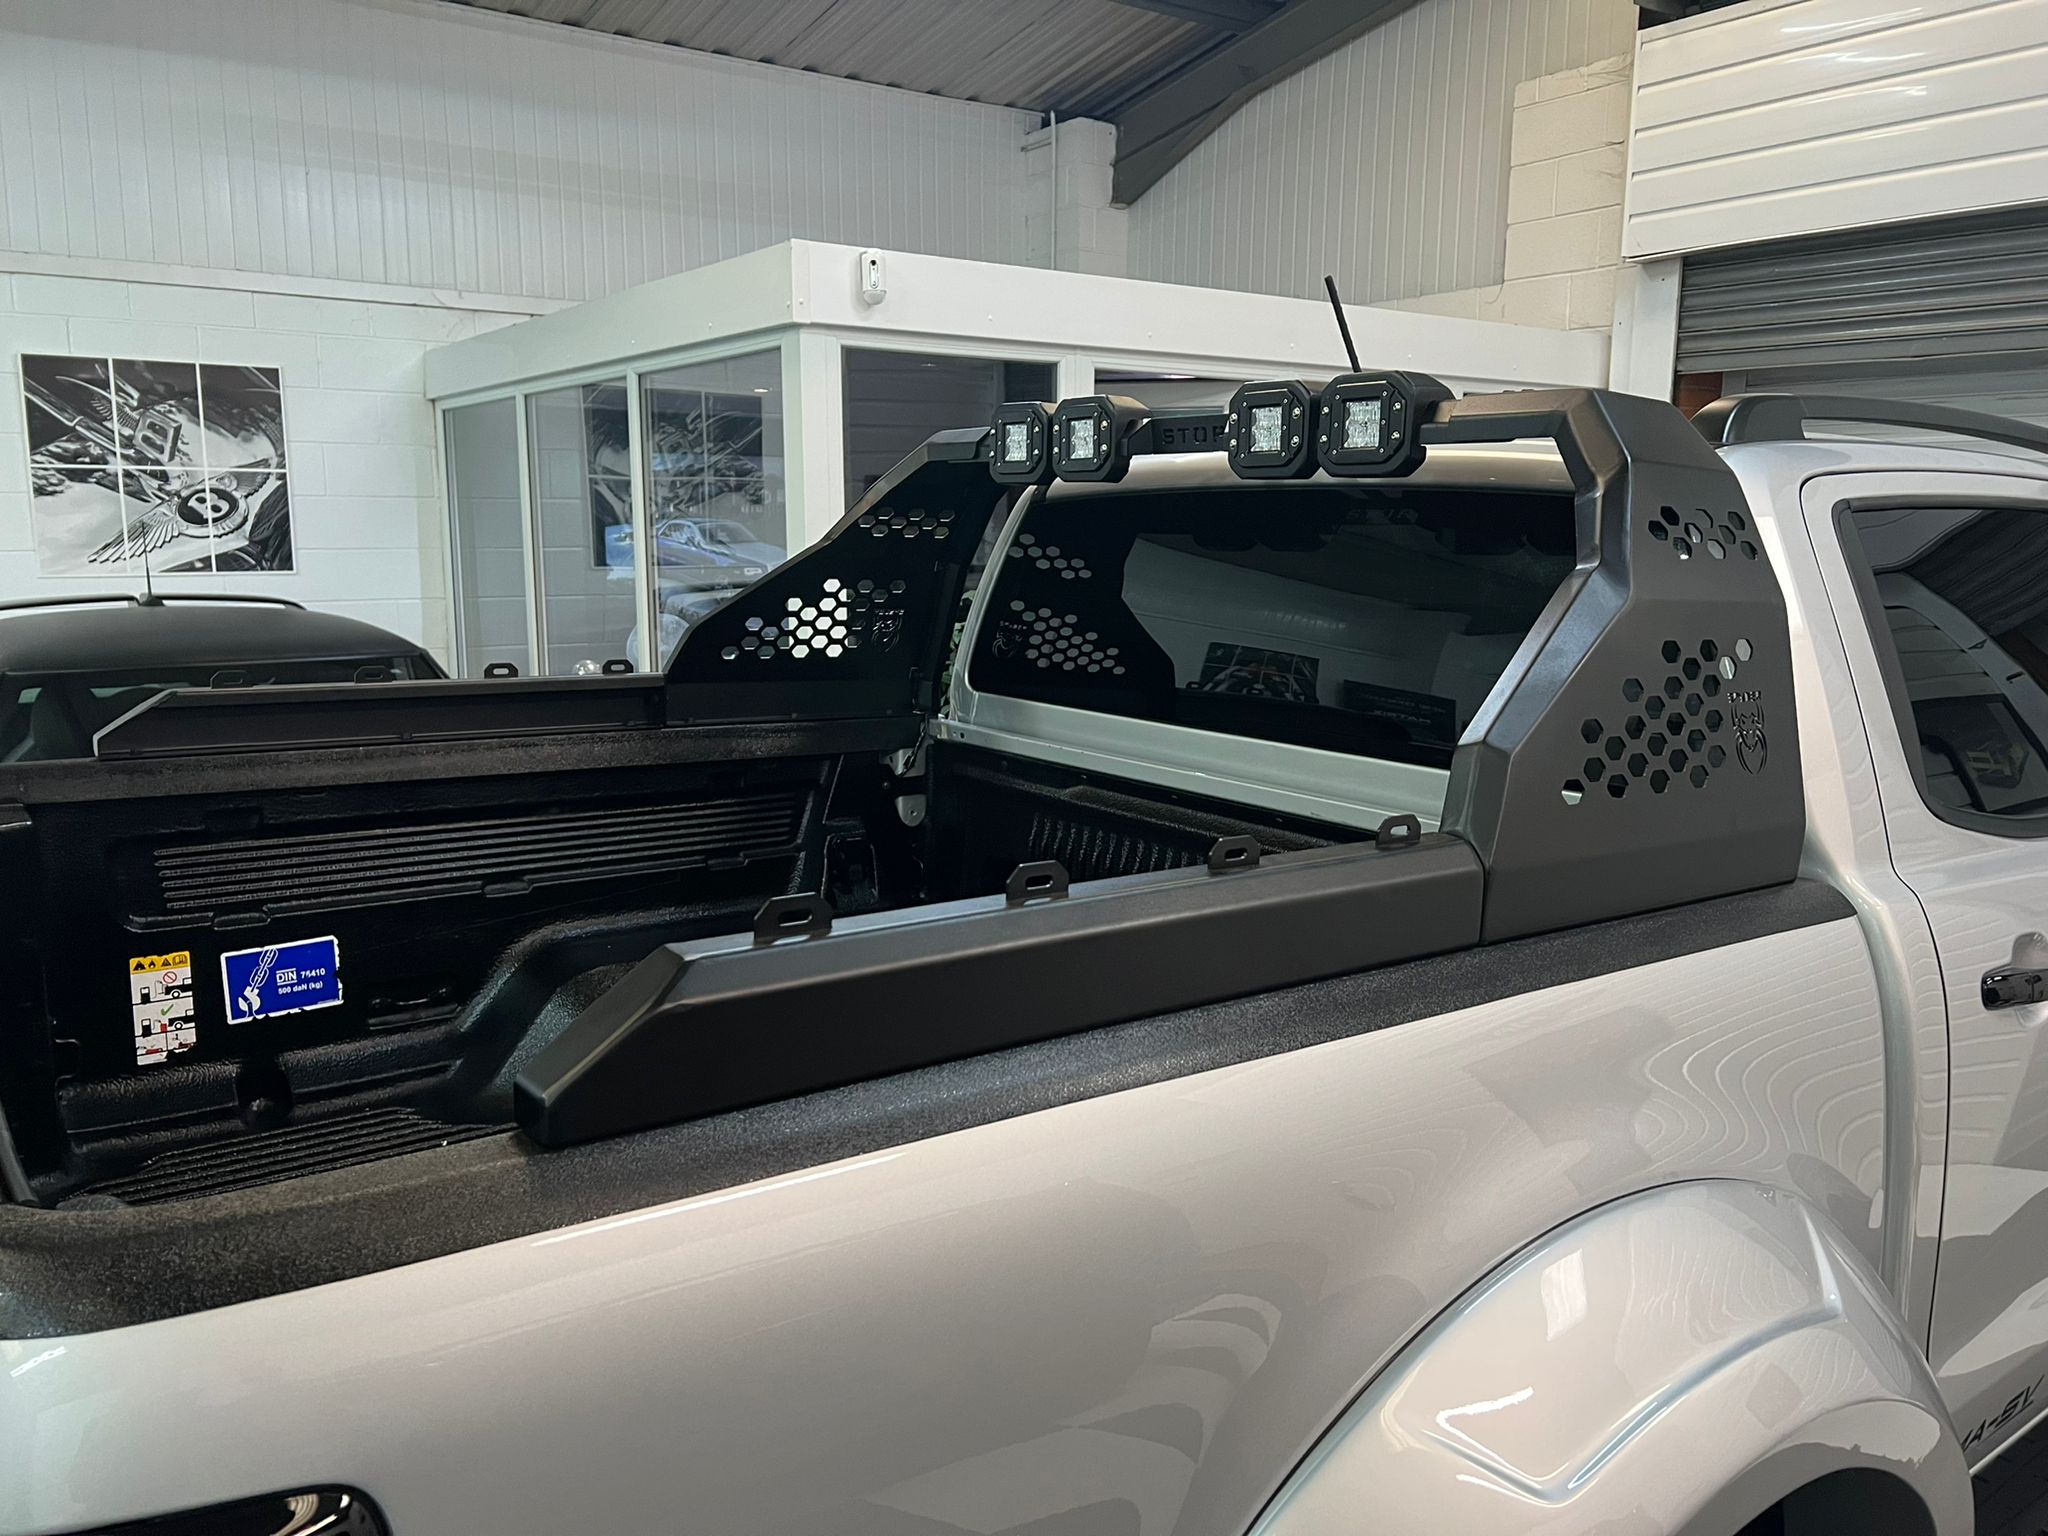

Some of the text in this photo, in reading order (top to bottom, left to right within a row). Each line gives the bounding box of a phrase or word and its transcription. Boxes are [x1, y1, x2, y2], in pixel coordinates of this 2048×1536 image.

[1161, 426, 1225, 444] STOP
[187, 491, 230, 519] B
[276, 970, 297, 983] DIN
[278, 981, 323, 994] 500 daN (kg)
